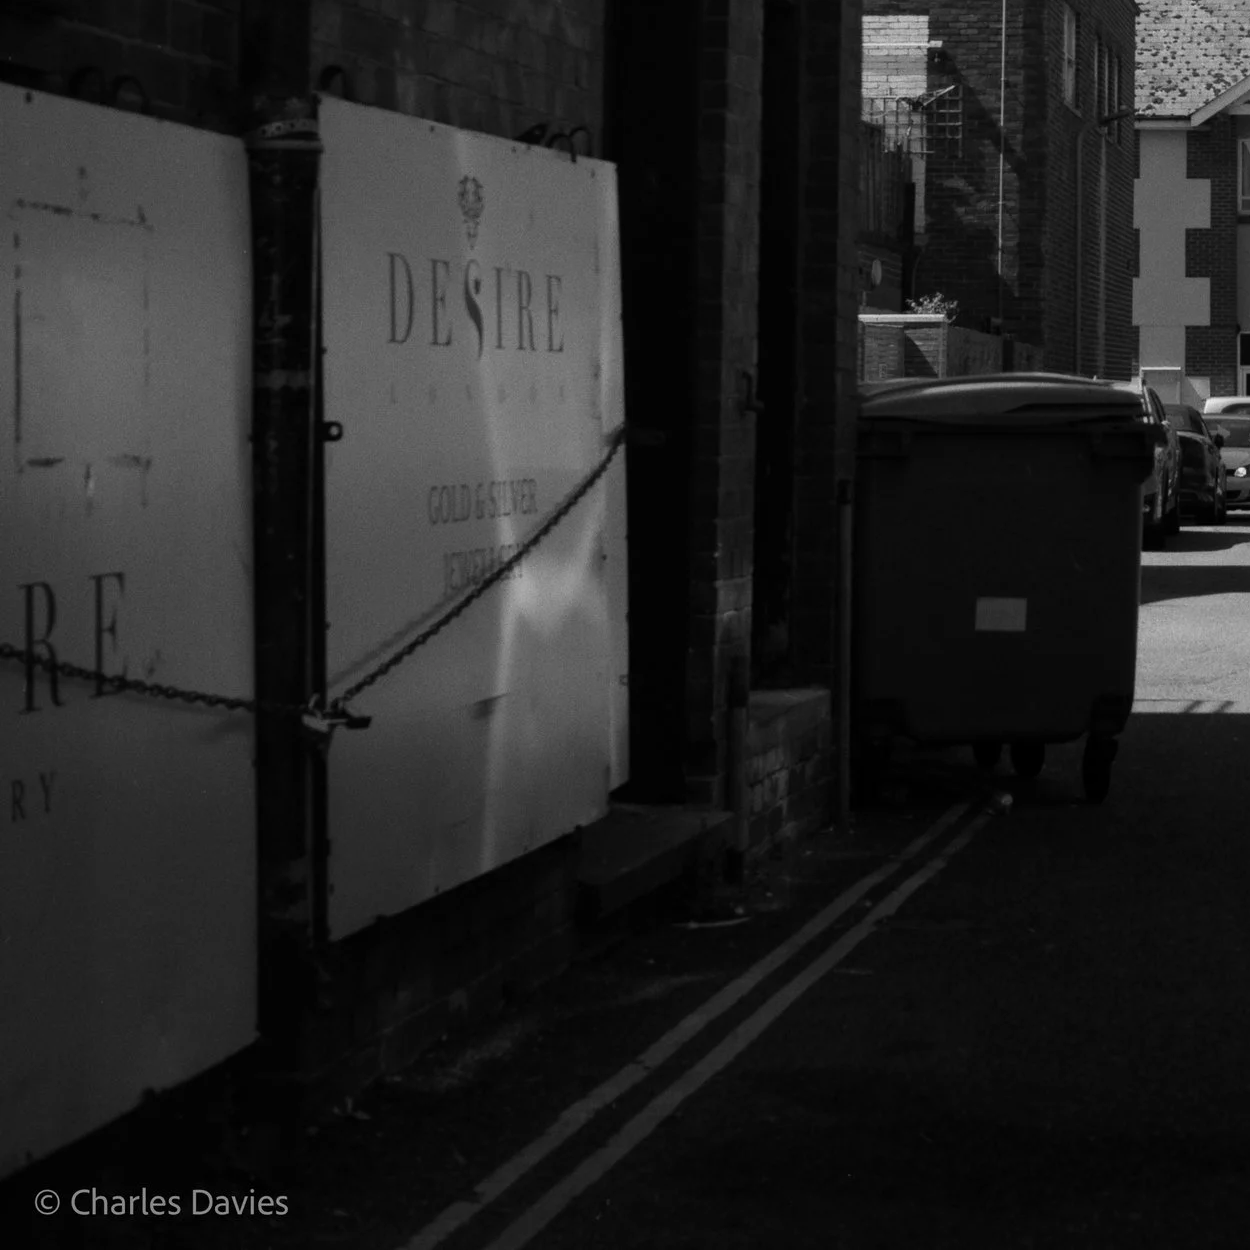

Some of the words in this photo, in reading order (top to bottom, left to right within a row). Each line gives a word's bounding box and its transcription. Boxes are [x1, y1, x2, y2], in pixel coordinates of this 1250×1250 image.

[387, 252, 564, 359] DESIRE
[428, 484, 471, 525] GOLD
[488, 478, 538, 519] SILVER
